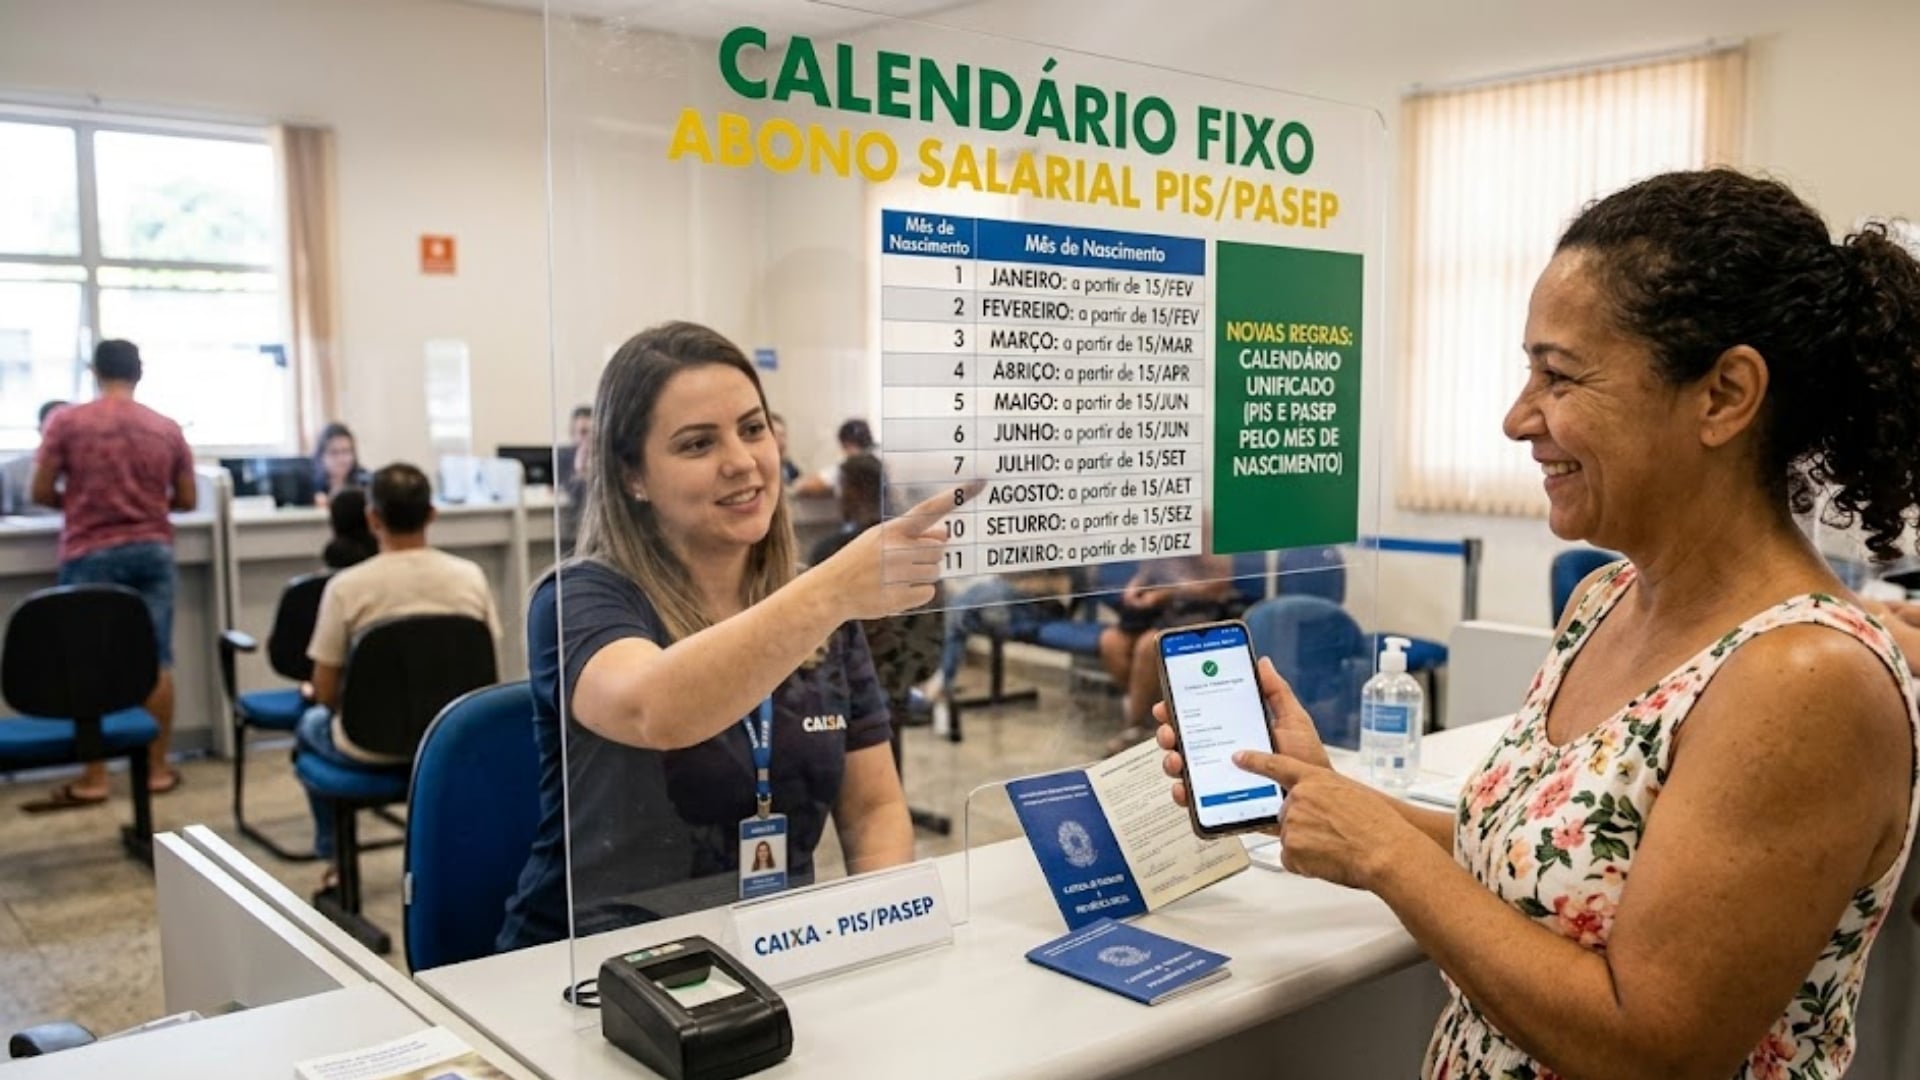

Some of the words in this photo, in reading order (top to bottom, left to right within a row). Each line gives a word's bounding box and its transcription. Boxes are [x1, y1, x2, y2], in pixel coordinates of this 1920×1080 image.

[718, 25, 1176, 156] CALENDÁRIO
[1197, 105, 1315, 175] FIXO
[666, 107, 900, 183] ABONO
[918, 138, 1141, 209] SALARIAL
[1155, 168, 1339, 230] PIS/PASEP
[937, 218, 955, 235] de
[889, 234, 970, 255] Nascimento
[1060, 235, 1080, 256] de
[1082, 238, 1166, 262] Nascimento
[955, 266, 963, 284] 1
[989, 267, 1067, 290] JANEIRO:
[1071, 279, 1080, 291] a
[1123, 277, 1141, 294] de
[1145, 278, 1194, 298] 15/FEV
[953, 299, 965, 317] 2
[982, 298, 1074, 321] FEVEREIRO:
[1078, 311, 1088, 321] a
[1130, 306, 1148, 324] de
[1152, 308, 1200, 327] 15/FEV
[953, 330, 965, 348] 3
[990, 330, 1059, 353] MARÇO:
[1062, 340, 1072, 350] a
[1116, 335, 1133, 352] de
[1137, 335, 1193, 354] 15/MAR
[1226, 320, 1285, 343] NOVAS
[1289, 323, 1353, 346] REGRAS:
[1239, 346, 1341, 371] CALENDÁRIO
[953, 361, 965, 379] 4
[1064, 370, 1074, 381] a
[1117, 363, 1134, 381] de
[1138, 364, 1190, 383] 15/APR
[1246, 376, 1335, 397] UNIFICADO
[953, 392, 965, 411] 5
[994, 392, 1059, 411] MAIGO:
[1062, 399, 1072, 411] a
[1115, 392, 1133, 411] de
[1136, 393, 1189, 412] 15/JUN
[1243, 402, 1273, 426] (PIS
[1277, 402, 1287, 421] E
[1290, 401, 1337, 421] PASEP
[953, 425, 965, 443] 6
[994, 423, 1059, 442] JUNHO:
[1064, 429, 1073, 441] a
[1116, 421, 1133, 439] de
[1137, 421, 1190, 441] 15/JUN
[1239, 429, 1280, 449] PELO
[1319, 427, 1340, 447] DE
[953, 456, 965, 475] 7
[1064, 460, 1074, 471] a
[1117, 451, 1133, 468] de
[1138, 449, 1187, 469] 15/SET
[1233, 453, 1343, 477] NASCIMENTO)
[954, 488, 965, 506] 8
[988, 483, 1064, 504] AGOSTO:
[1068, 489, 1078, 500] a
[1121, 480, 1137, 498] de
[1141, 477, 1192, 497] 15/AET
[945, 519, 965, 538] 10
[987, 513, 1067, 536] SETURRO:
[1070, 518, 1080, 529] a
[1121, 508, 1139, 526] de
[1143, 505, 1193, 526] 15/SEZ
[1068, 549, 1077, 559] a
[1120, 538, 1137, 556] de
[1141, 533, 1191, 556] 15/DEZ
[945, 551, 962, 569] 11
[754, 924, 821, 956] CAIXA
[837, 895, 935, 937] PIS/PASEP
